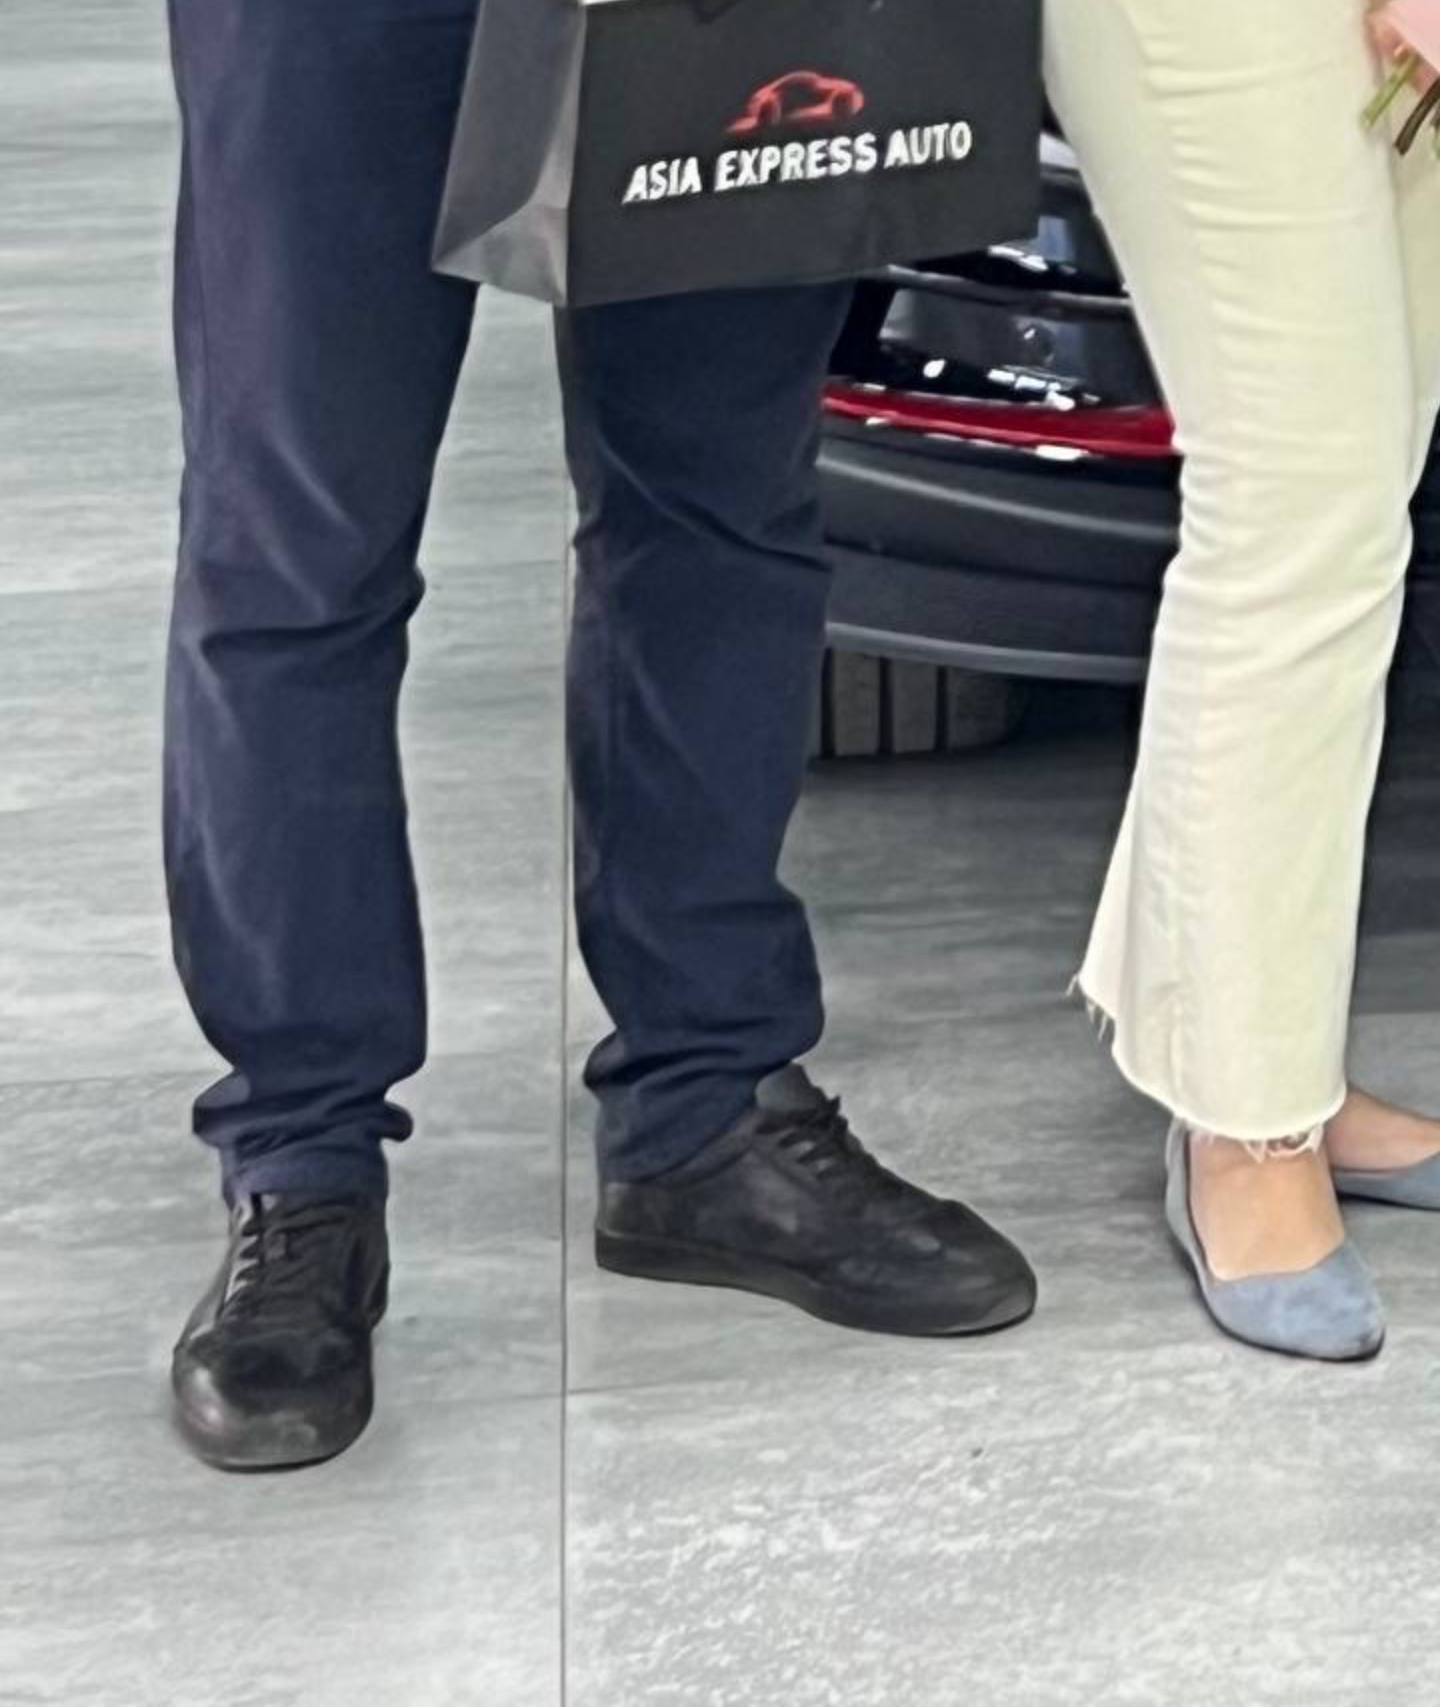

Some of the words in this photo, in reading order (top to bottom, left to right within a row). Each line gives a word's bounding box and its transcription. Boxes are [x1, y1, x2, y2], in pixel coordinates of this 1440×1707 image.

[622, 157, 702, 204] ASIA
[714, 132, 877, 192] EXPRESS
[884, 121, 973, 168] AUTO
